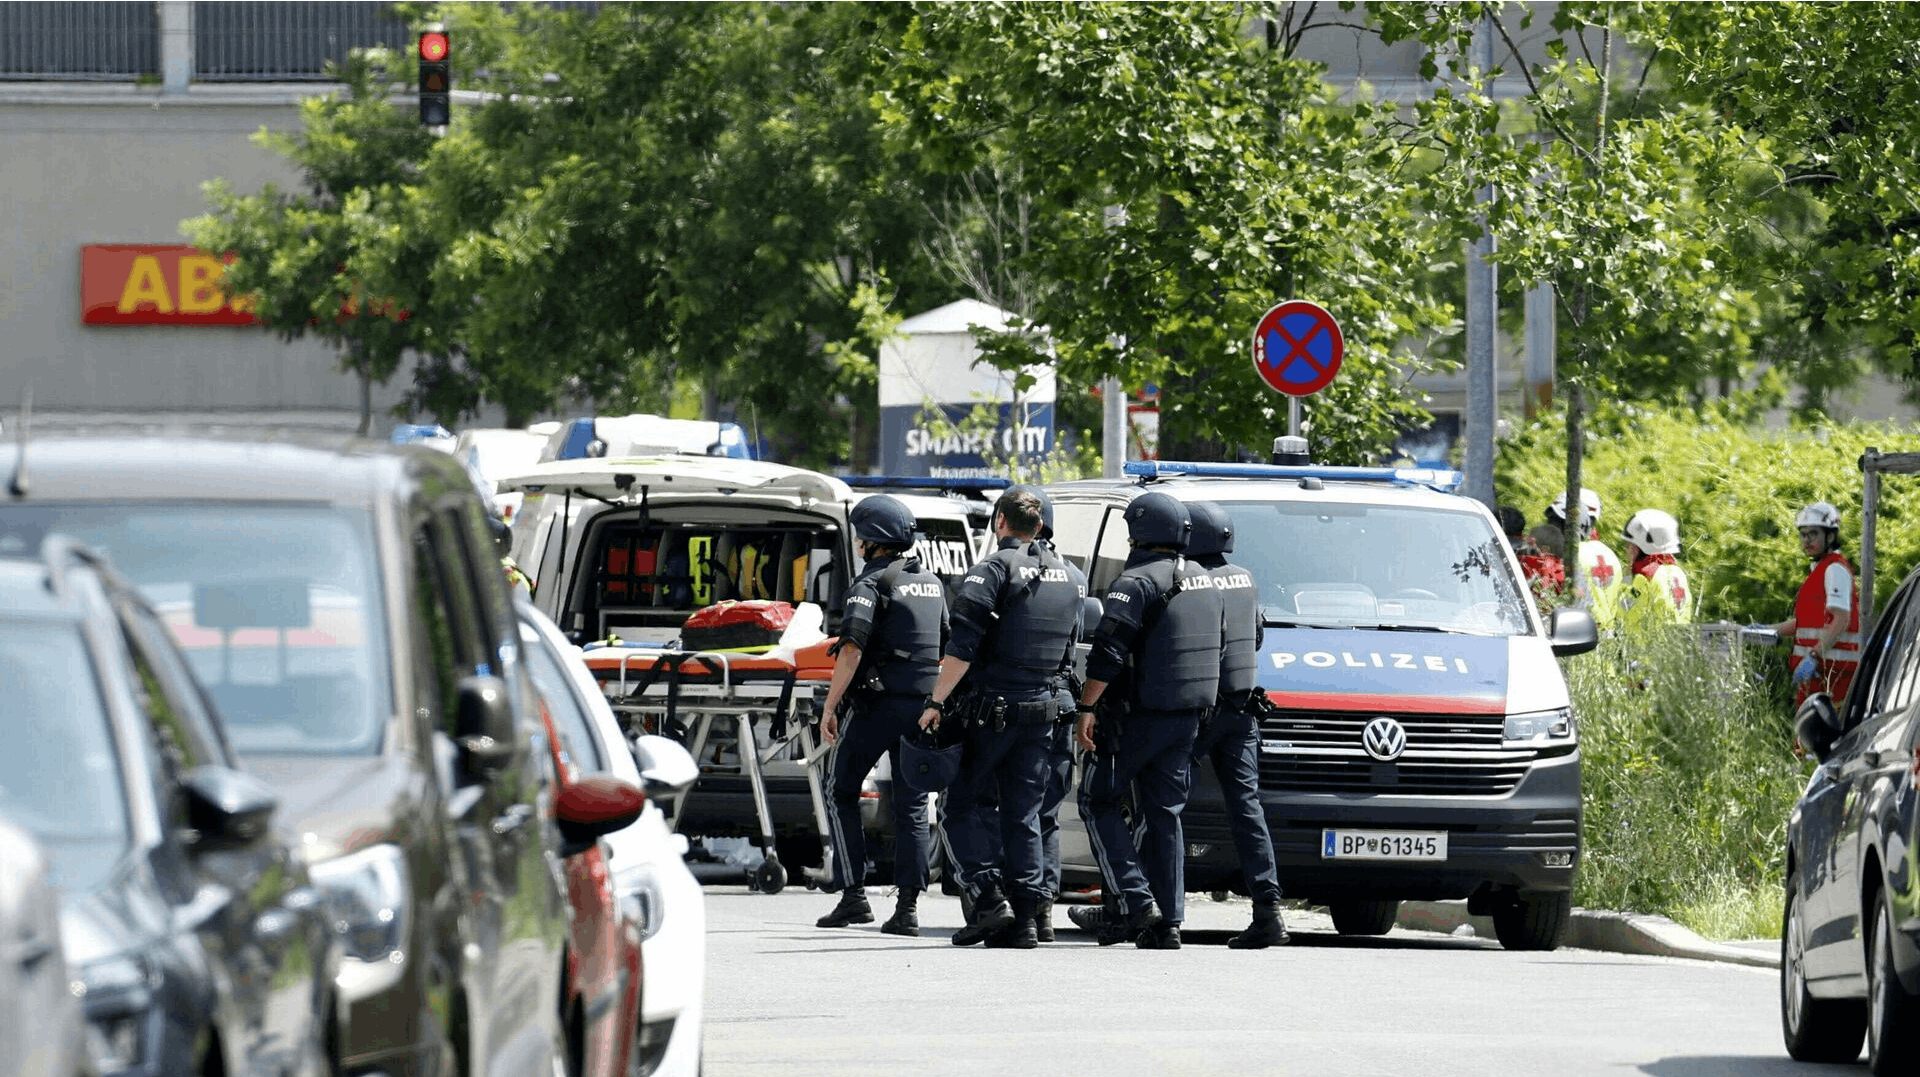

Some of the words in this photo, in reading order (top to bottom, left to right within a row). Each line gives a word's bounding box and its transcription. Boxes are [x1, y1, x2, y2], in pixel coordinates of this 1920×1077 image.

[902, 539, 968, 575] OTARZT
[899, 583, 941, 597] POLIZEI
[1179, 575, 1213, 591] OLIZEI
[1213, 574, 1251, 590] OLIZEI
[846, 595, 873, 608] POLIZEI
[1270, 651, 1469, 674] POLIZEI
[1343, 836, 1366, 854] BP
[1380, 836, 1437, 856] 61345
